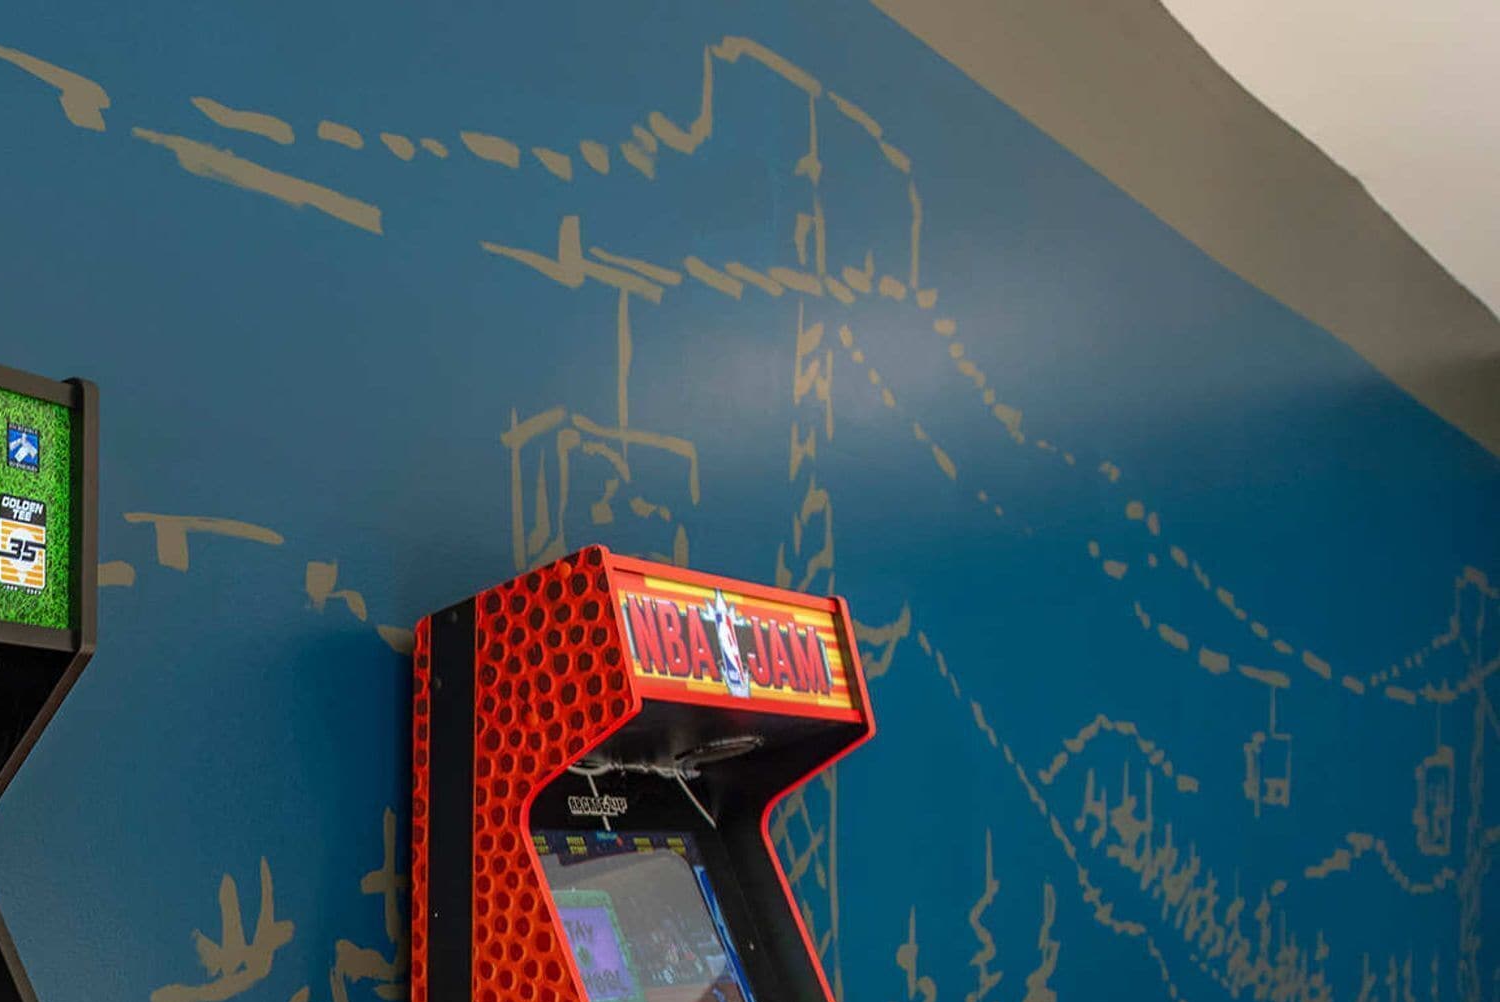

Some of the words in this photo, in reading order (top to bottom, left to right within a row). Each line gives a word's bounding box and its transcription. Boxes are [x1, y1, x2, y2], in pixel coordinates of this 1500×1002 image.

[1, 496, 44, 515] GOLDEN
[12, 508, 33, 522] TEE
[3, 538, 42, 562] 35
[626, 593, 722, 682] NBA
[748, 615, 840, 696] JAM
